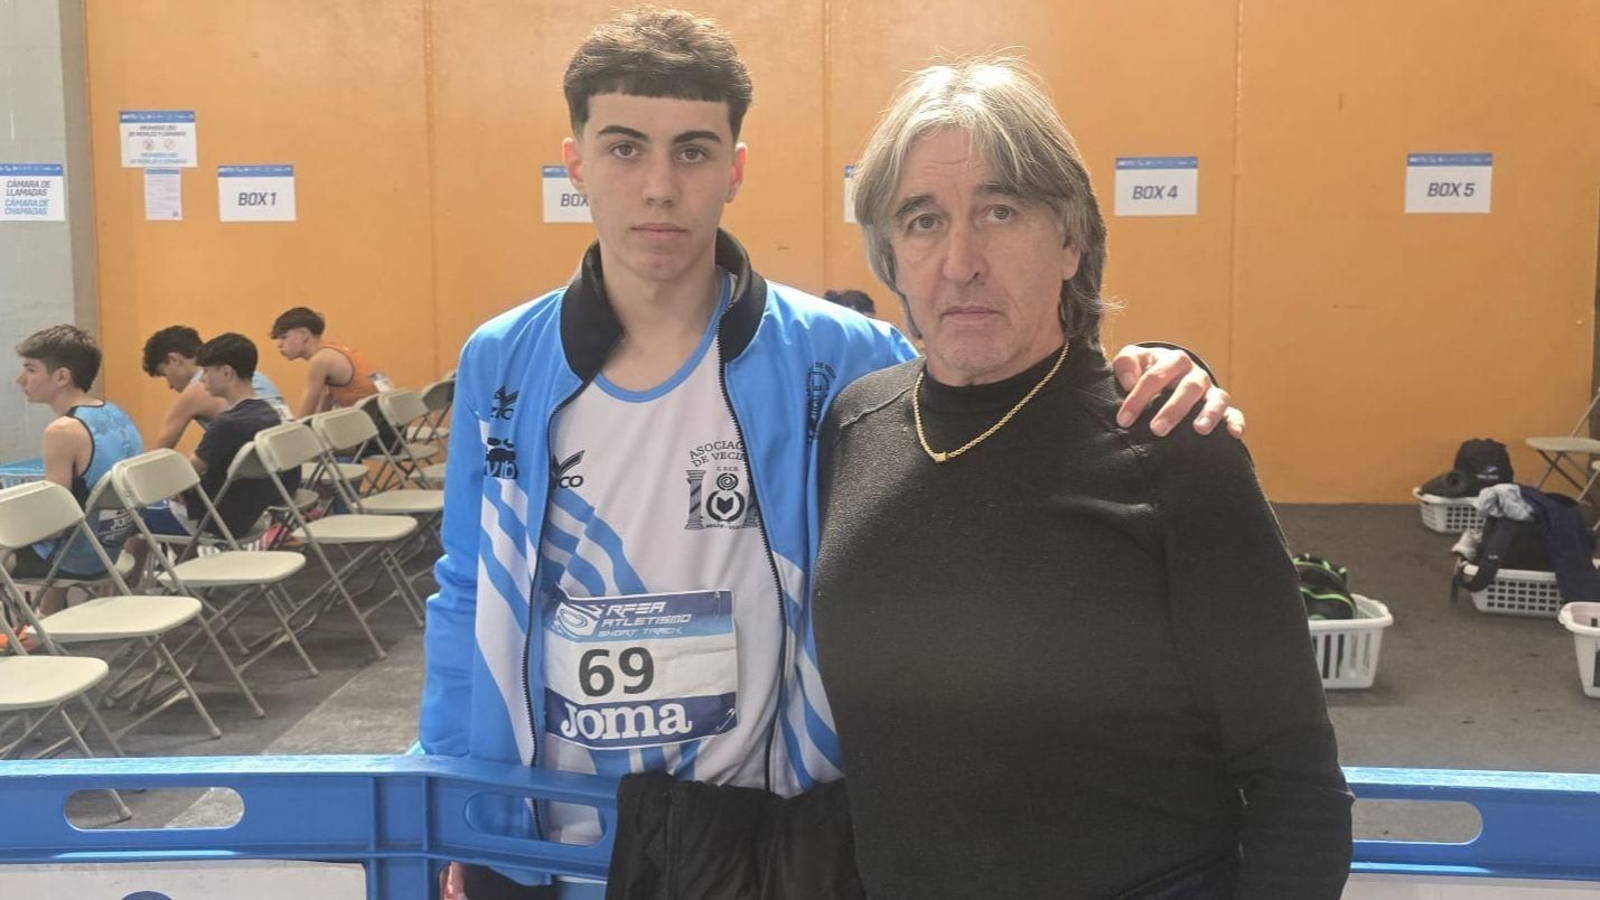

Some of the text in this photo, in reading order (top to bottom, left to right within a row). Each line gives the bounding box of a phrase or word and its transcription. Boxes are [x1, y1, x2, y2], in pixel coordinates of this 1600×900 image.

[40, 180, 51, 188] DE
[1427, 182, 1476, 198] BOX 5
[6, 188, 48, 197] LLAMADAS
[238, 192, 277, 207] BOX 1
[561, 193, 589, 207] BOX
[1132, 185, 1178, 200] BOX 4
[689, 440, 744, 460] ASOCIAC
[691, 451, 745, 468] DE VECI
[605, 601, 667, 618] RFEA
[601, 614, 693, 628] ATLETISMO
[643, 626, 683, 635] TRACK
[578, 646, 655, 698] 69
[560, 702, 693, 741] Joma
